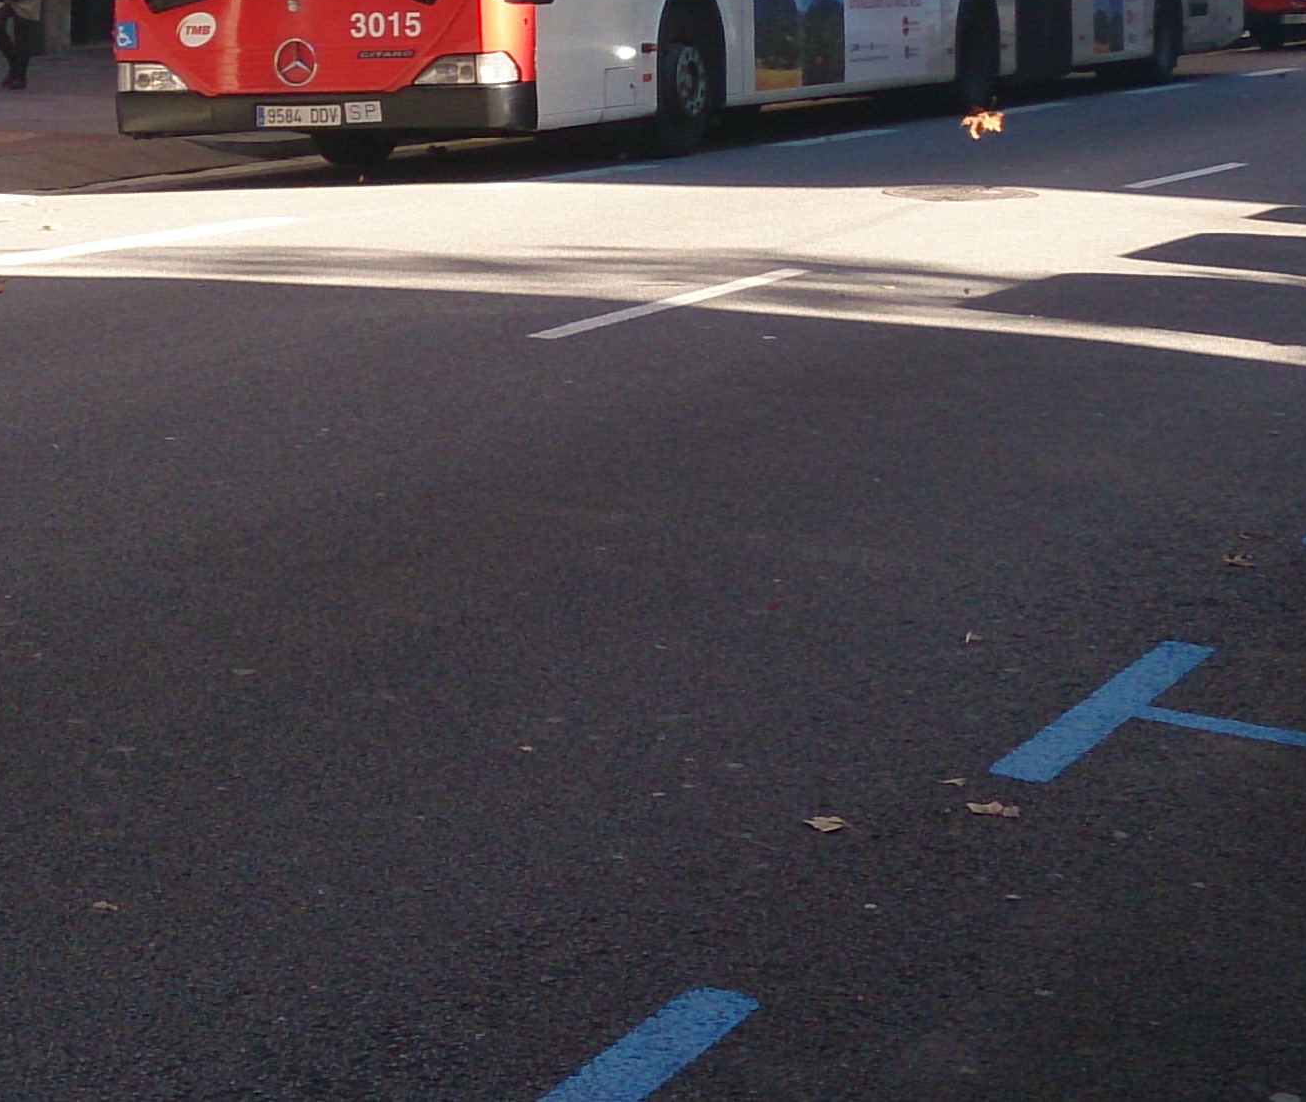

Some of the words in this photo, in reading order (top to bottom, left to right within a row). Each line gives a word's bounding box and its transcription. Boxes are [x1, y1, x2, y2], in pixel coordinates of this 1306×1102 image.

[184, 25, 211, 36] TMB
[349, 11, 422, 39] 3015
[267, 108, 302, 124] 9584
[310, 107, 337, 124] DDV
